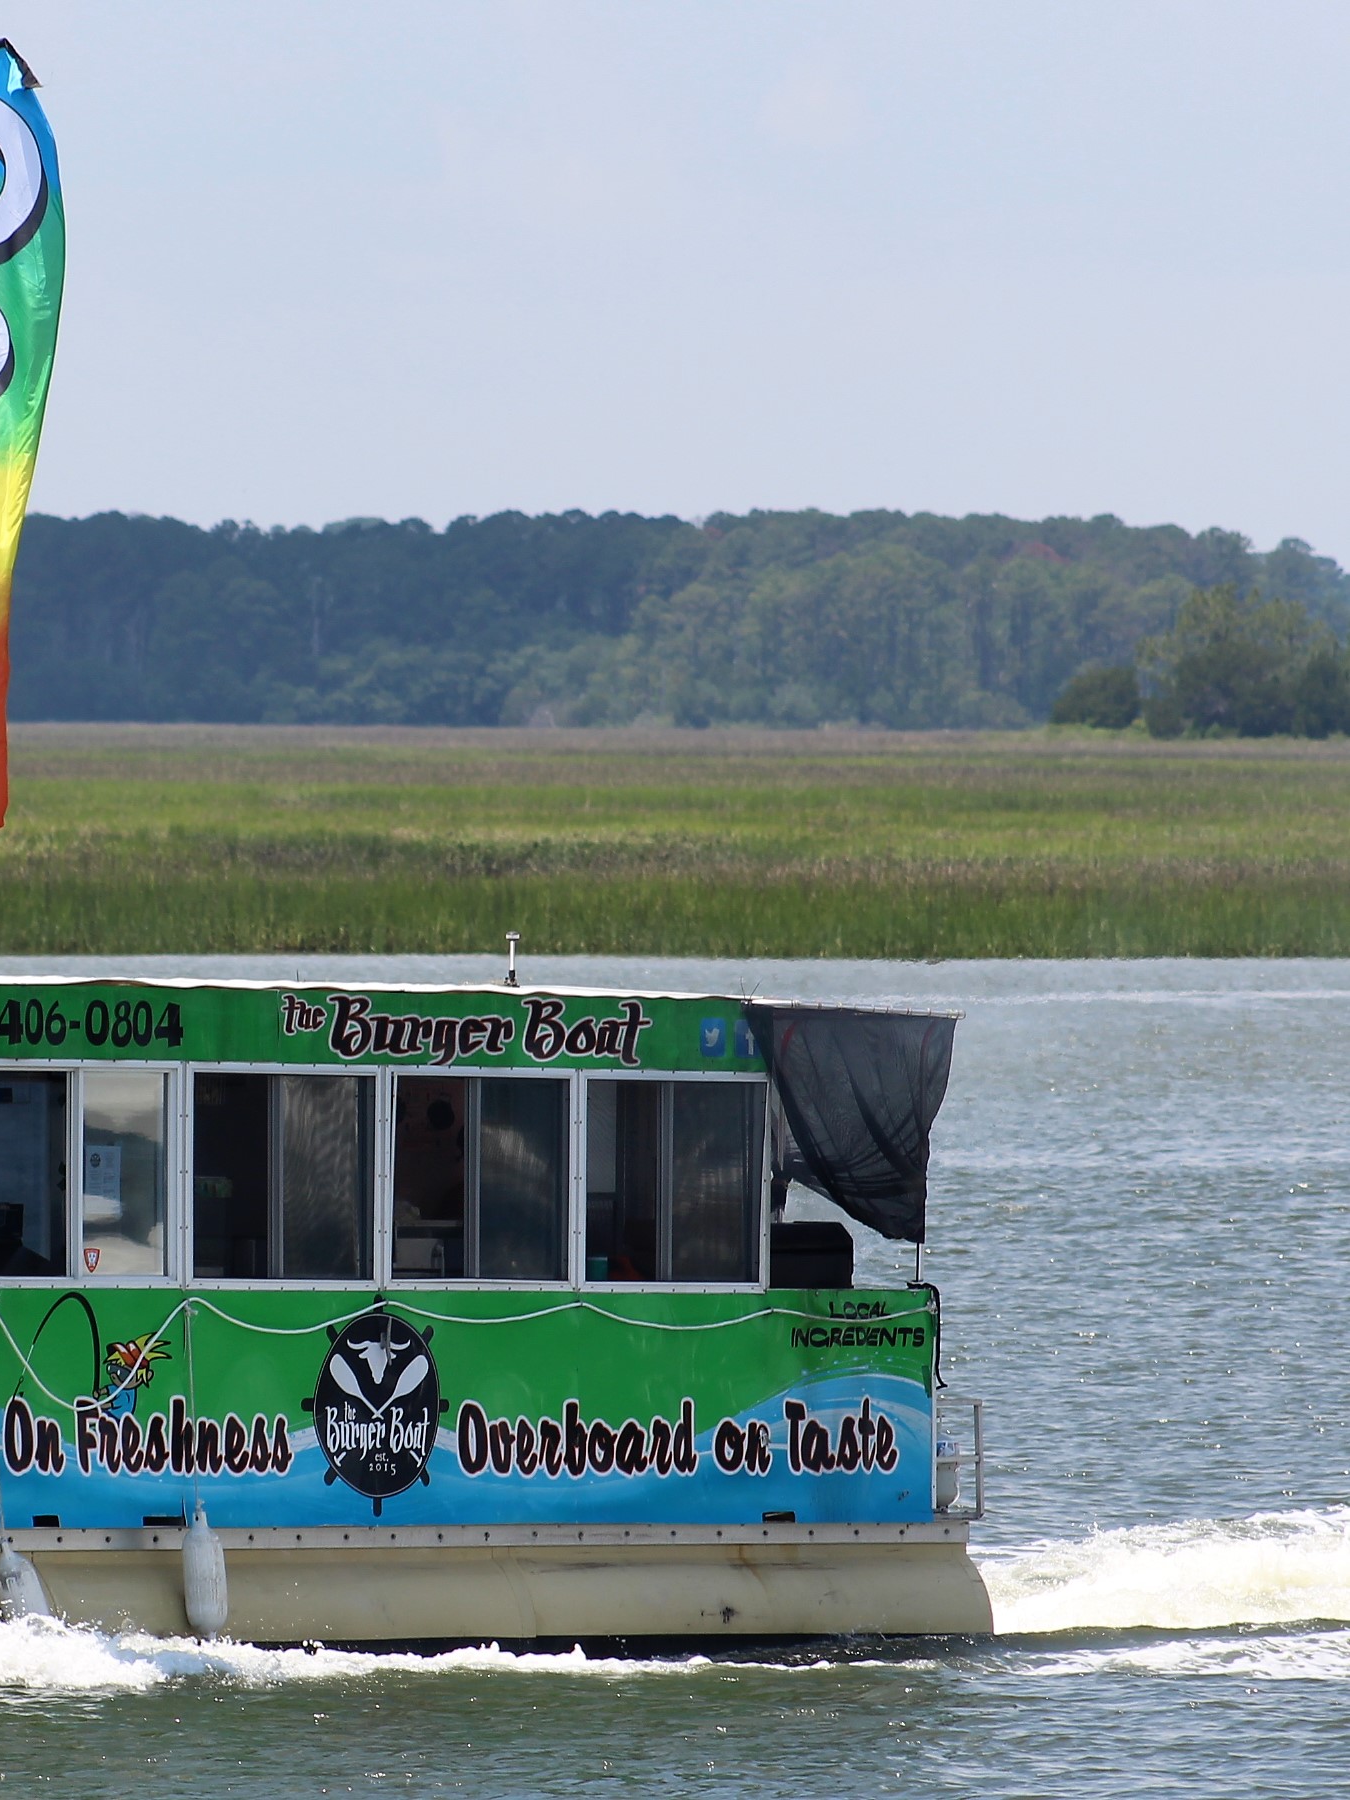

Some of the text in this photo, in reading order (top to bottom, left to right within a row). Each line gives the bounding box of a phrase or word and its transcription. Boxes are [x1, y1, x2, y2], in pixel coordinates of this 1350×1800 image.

[281, 995, 651, 1066] the Burger Boat
[828, 1300, 891, 1320] LOCAL
[2, 1396, 67, 1476] On
[74, 1394, 295, 1478] Freshness
[325, 1401, 430, 1460] the Burger Boat
[374, 1452, 389, 1462] est.
[457, 1396, 899, 1478] Overboard on Taste
[368, 1463, 396, 1476] 2015
